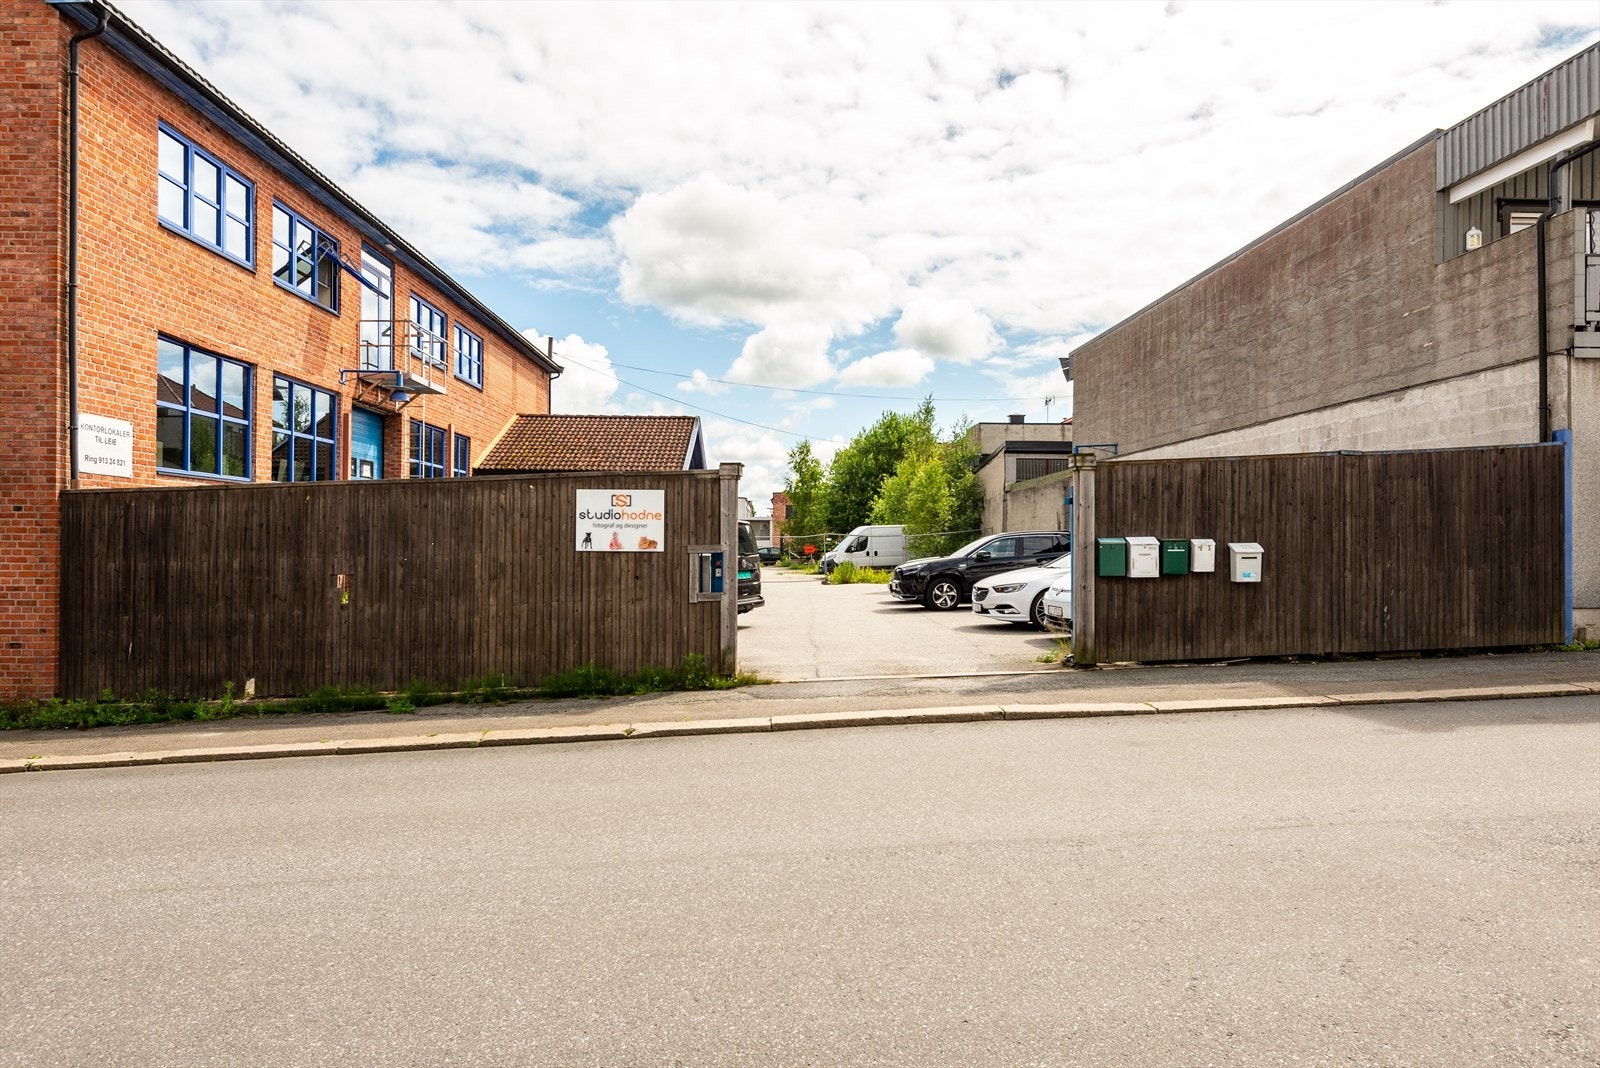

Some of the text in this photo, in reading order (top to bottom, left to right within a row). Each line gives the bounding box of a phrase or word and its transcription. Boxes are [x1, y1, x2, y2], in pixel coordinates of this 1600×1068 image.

[80, 424, 131, 438] KONTORLOKALER
[95, 435, 117, 446] TIL LEIE
[84, 454, 98, 465] Ring
[578, 509, 662, 520] studiohodne
